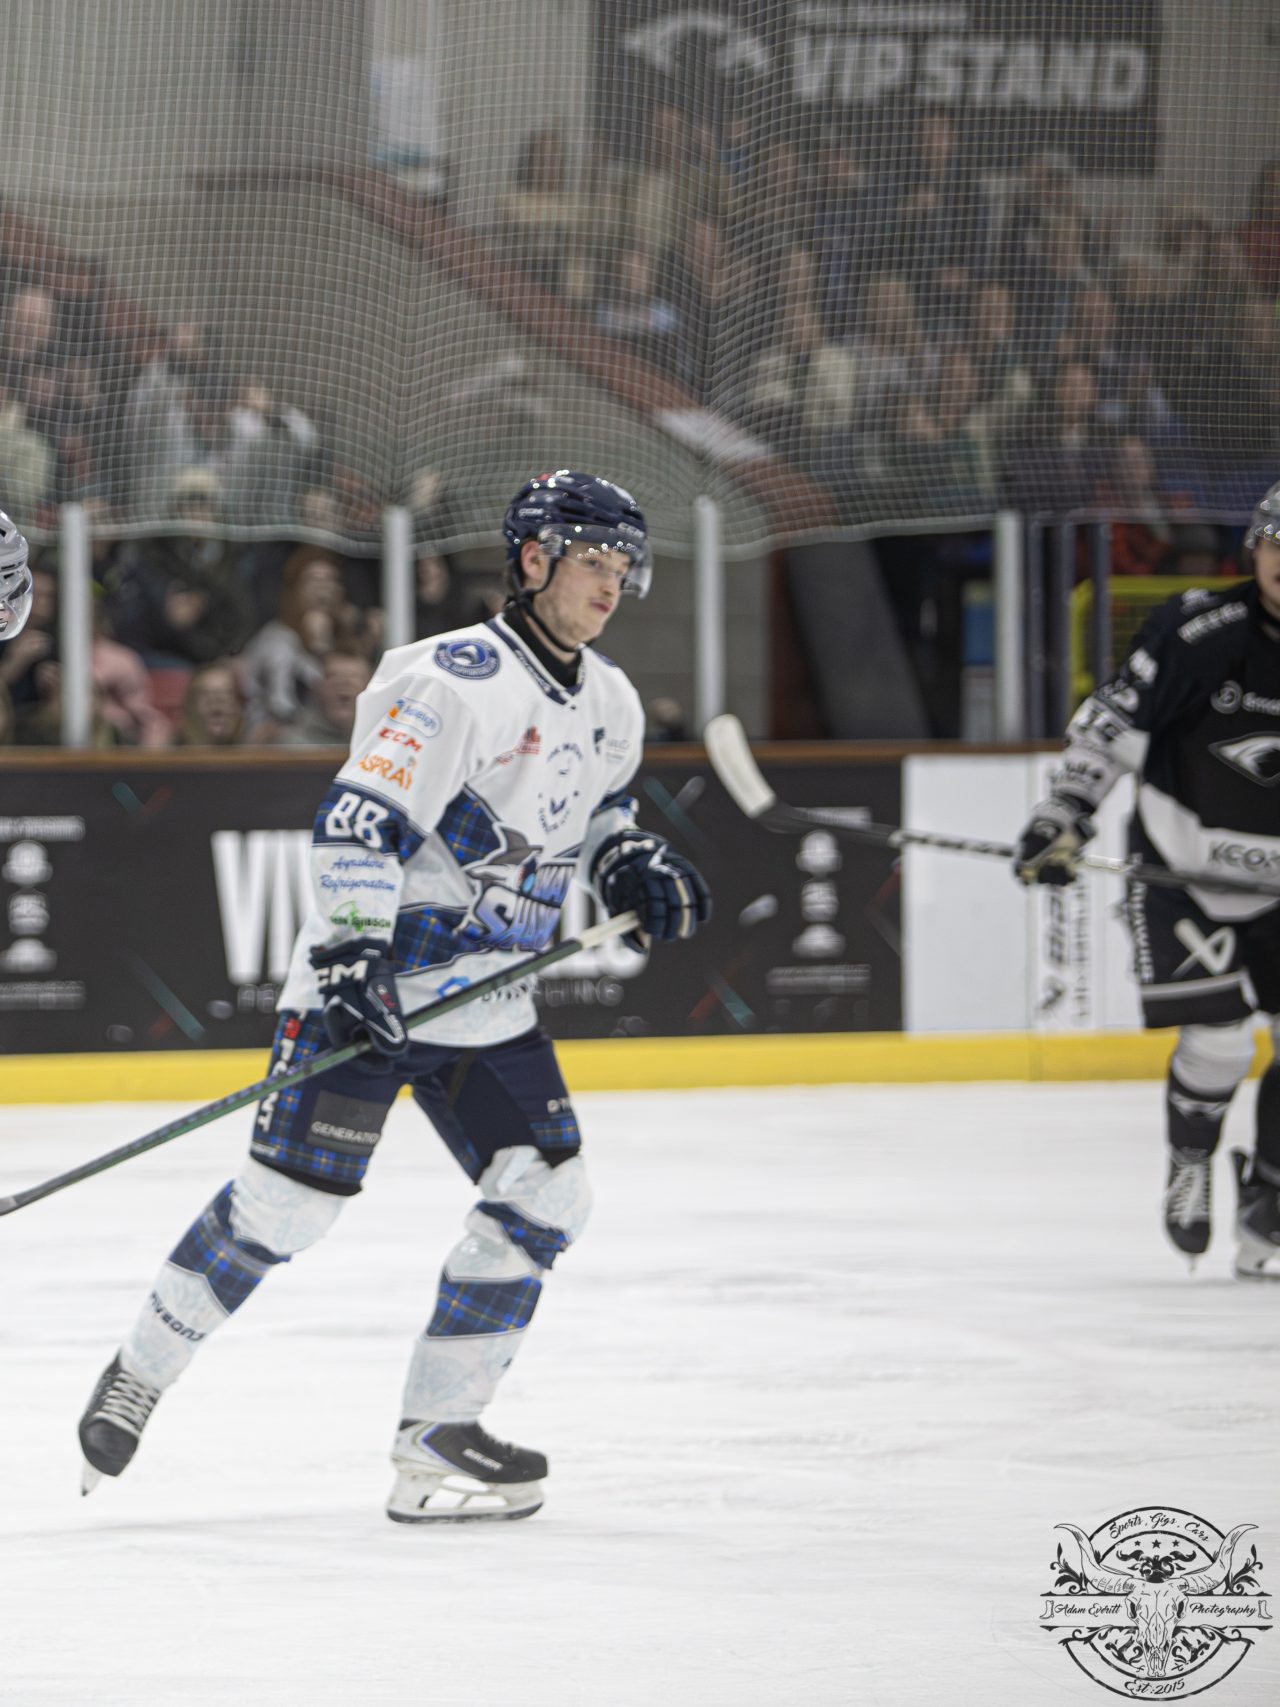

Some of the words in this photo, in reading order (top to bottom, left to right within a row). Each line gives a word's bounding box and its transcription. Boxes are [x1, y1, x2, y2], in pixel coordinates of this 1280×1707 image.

[791, 33, 907, 106] VIP
[919, 39, 1153, 109] STAND
[378, 727, 424, 752] CCM
[326, 792, 389, 848] 88
